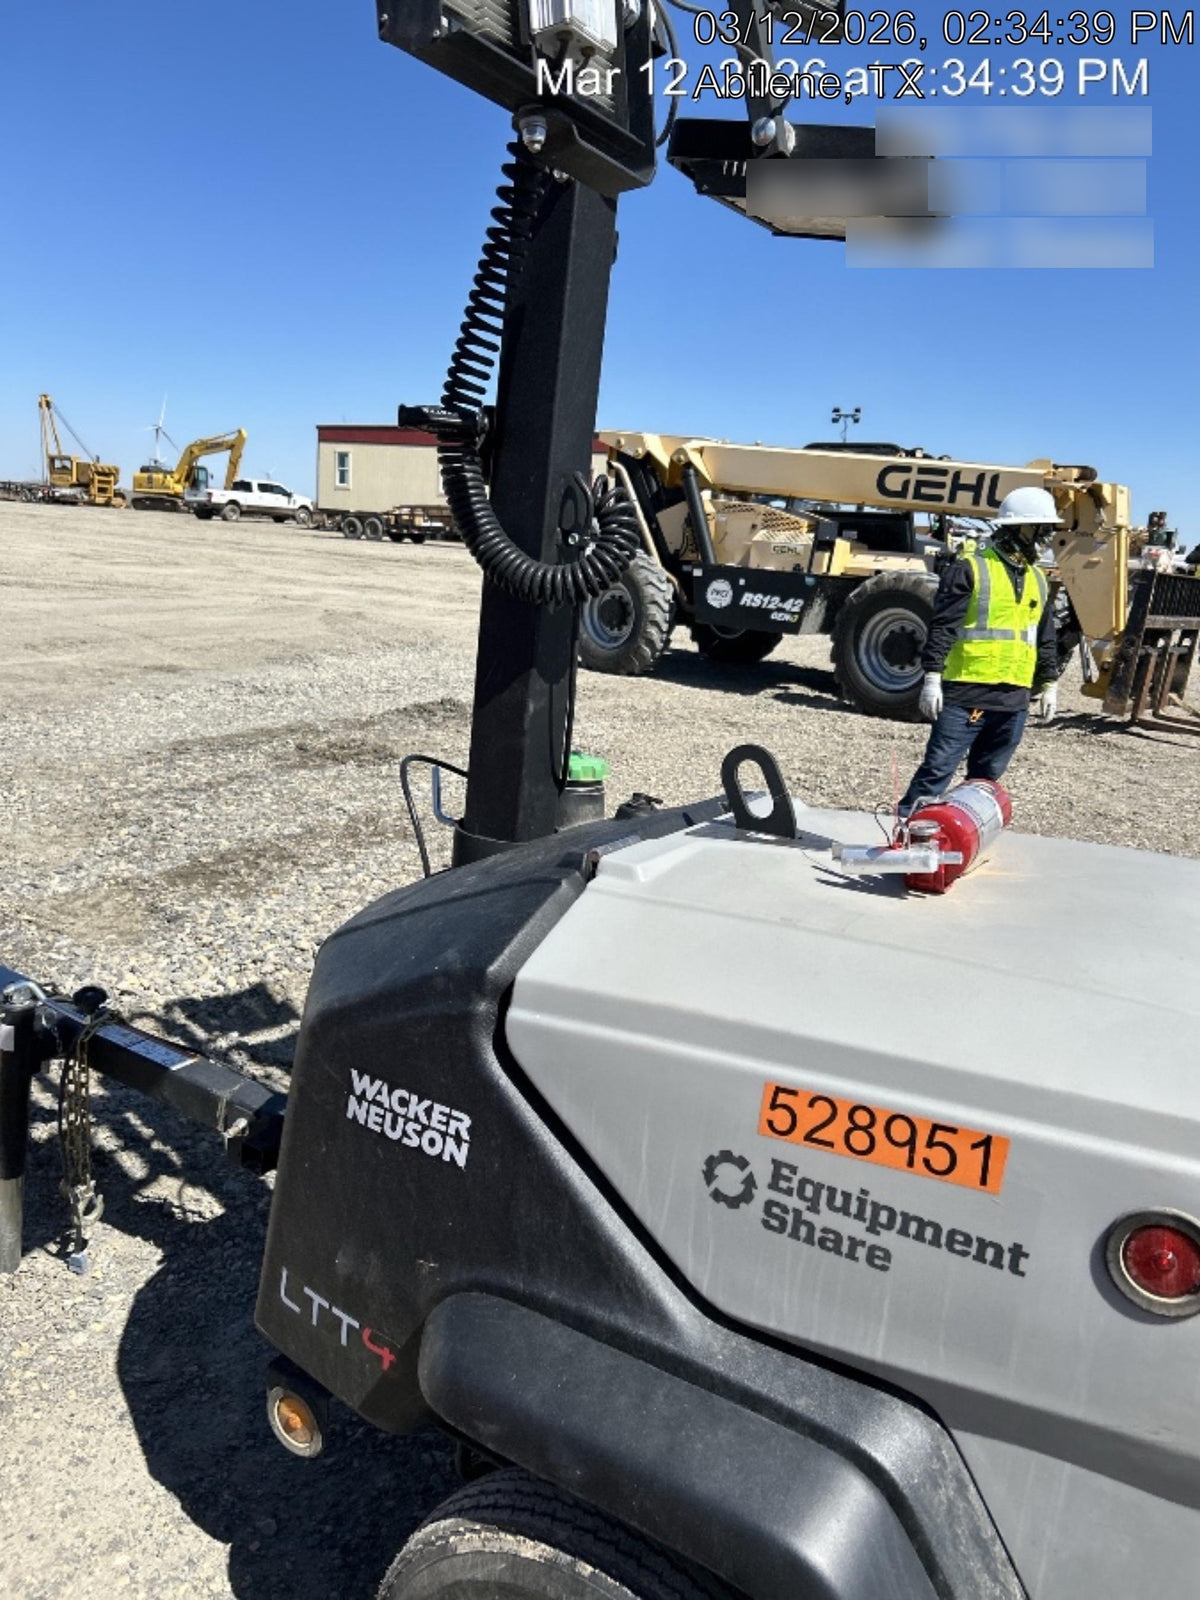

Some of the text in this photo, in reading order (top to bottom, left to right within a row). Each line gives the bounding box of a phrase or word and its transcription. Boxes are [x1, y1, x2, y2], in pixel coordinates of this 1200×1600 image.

[876, 464, 1003, 509] GEHL
[739, 592, 805, 612] RS12-42
[346, 1094, 471, 1171] NEUSON
[349, 1067, 472, 1141] WACKER
[765, 1085, 994, 1187] 528951
[760, 1199, 893, 1272] Share
[767, 1158, 1030, 1278] Equipment
